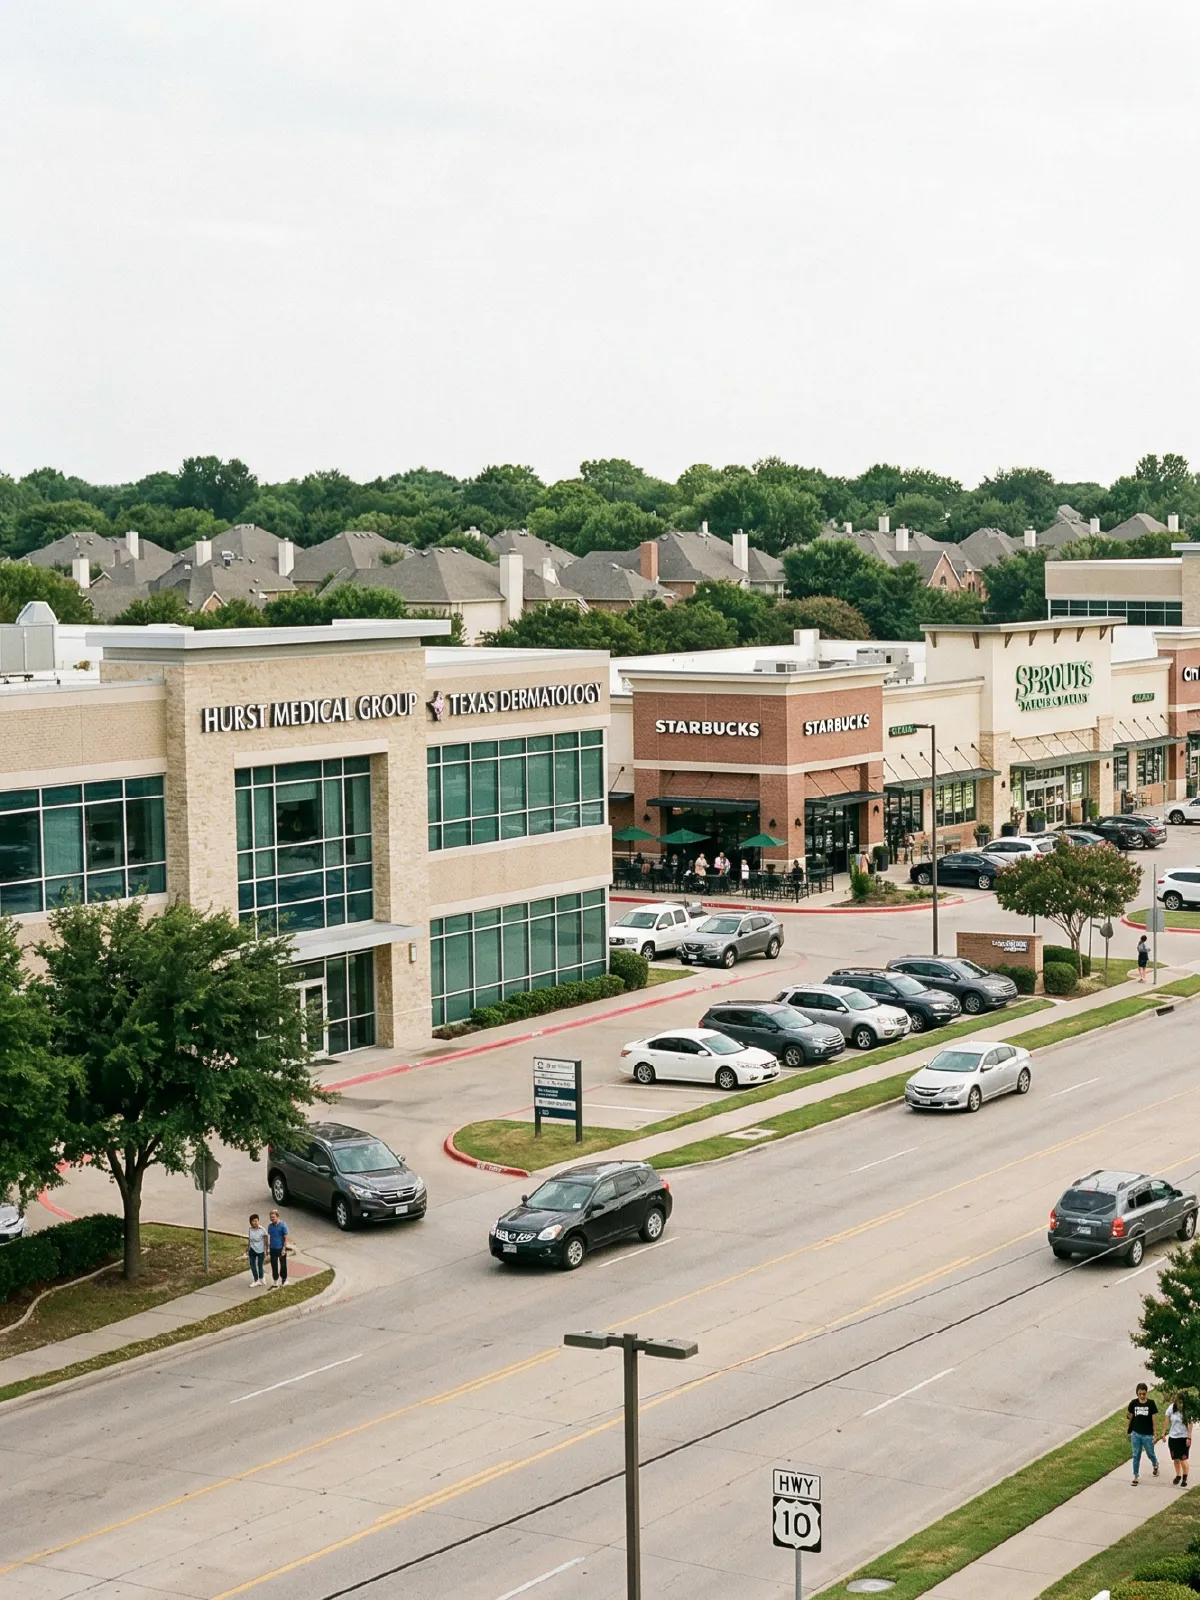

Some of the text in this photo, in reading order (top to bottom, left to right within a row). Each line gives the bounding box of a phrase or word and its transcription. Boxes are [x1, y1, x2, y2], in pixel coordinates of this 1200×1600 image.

[1016, 660, 1093, 702] SPROUTS
[203, 692, 418, 732] HURST MEDICAL GROUP
[449, 682, 602, 715] TEXAS DERMATOLOGY
[655, 720, 760, 737] STARBUCKS
[804, 713, 870, 736] STARBUCKS
[780, 1475, 813, 1495] HWY
[783, 1510, 811, 1538] 10
